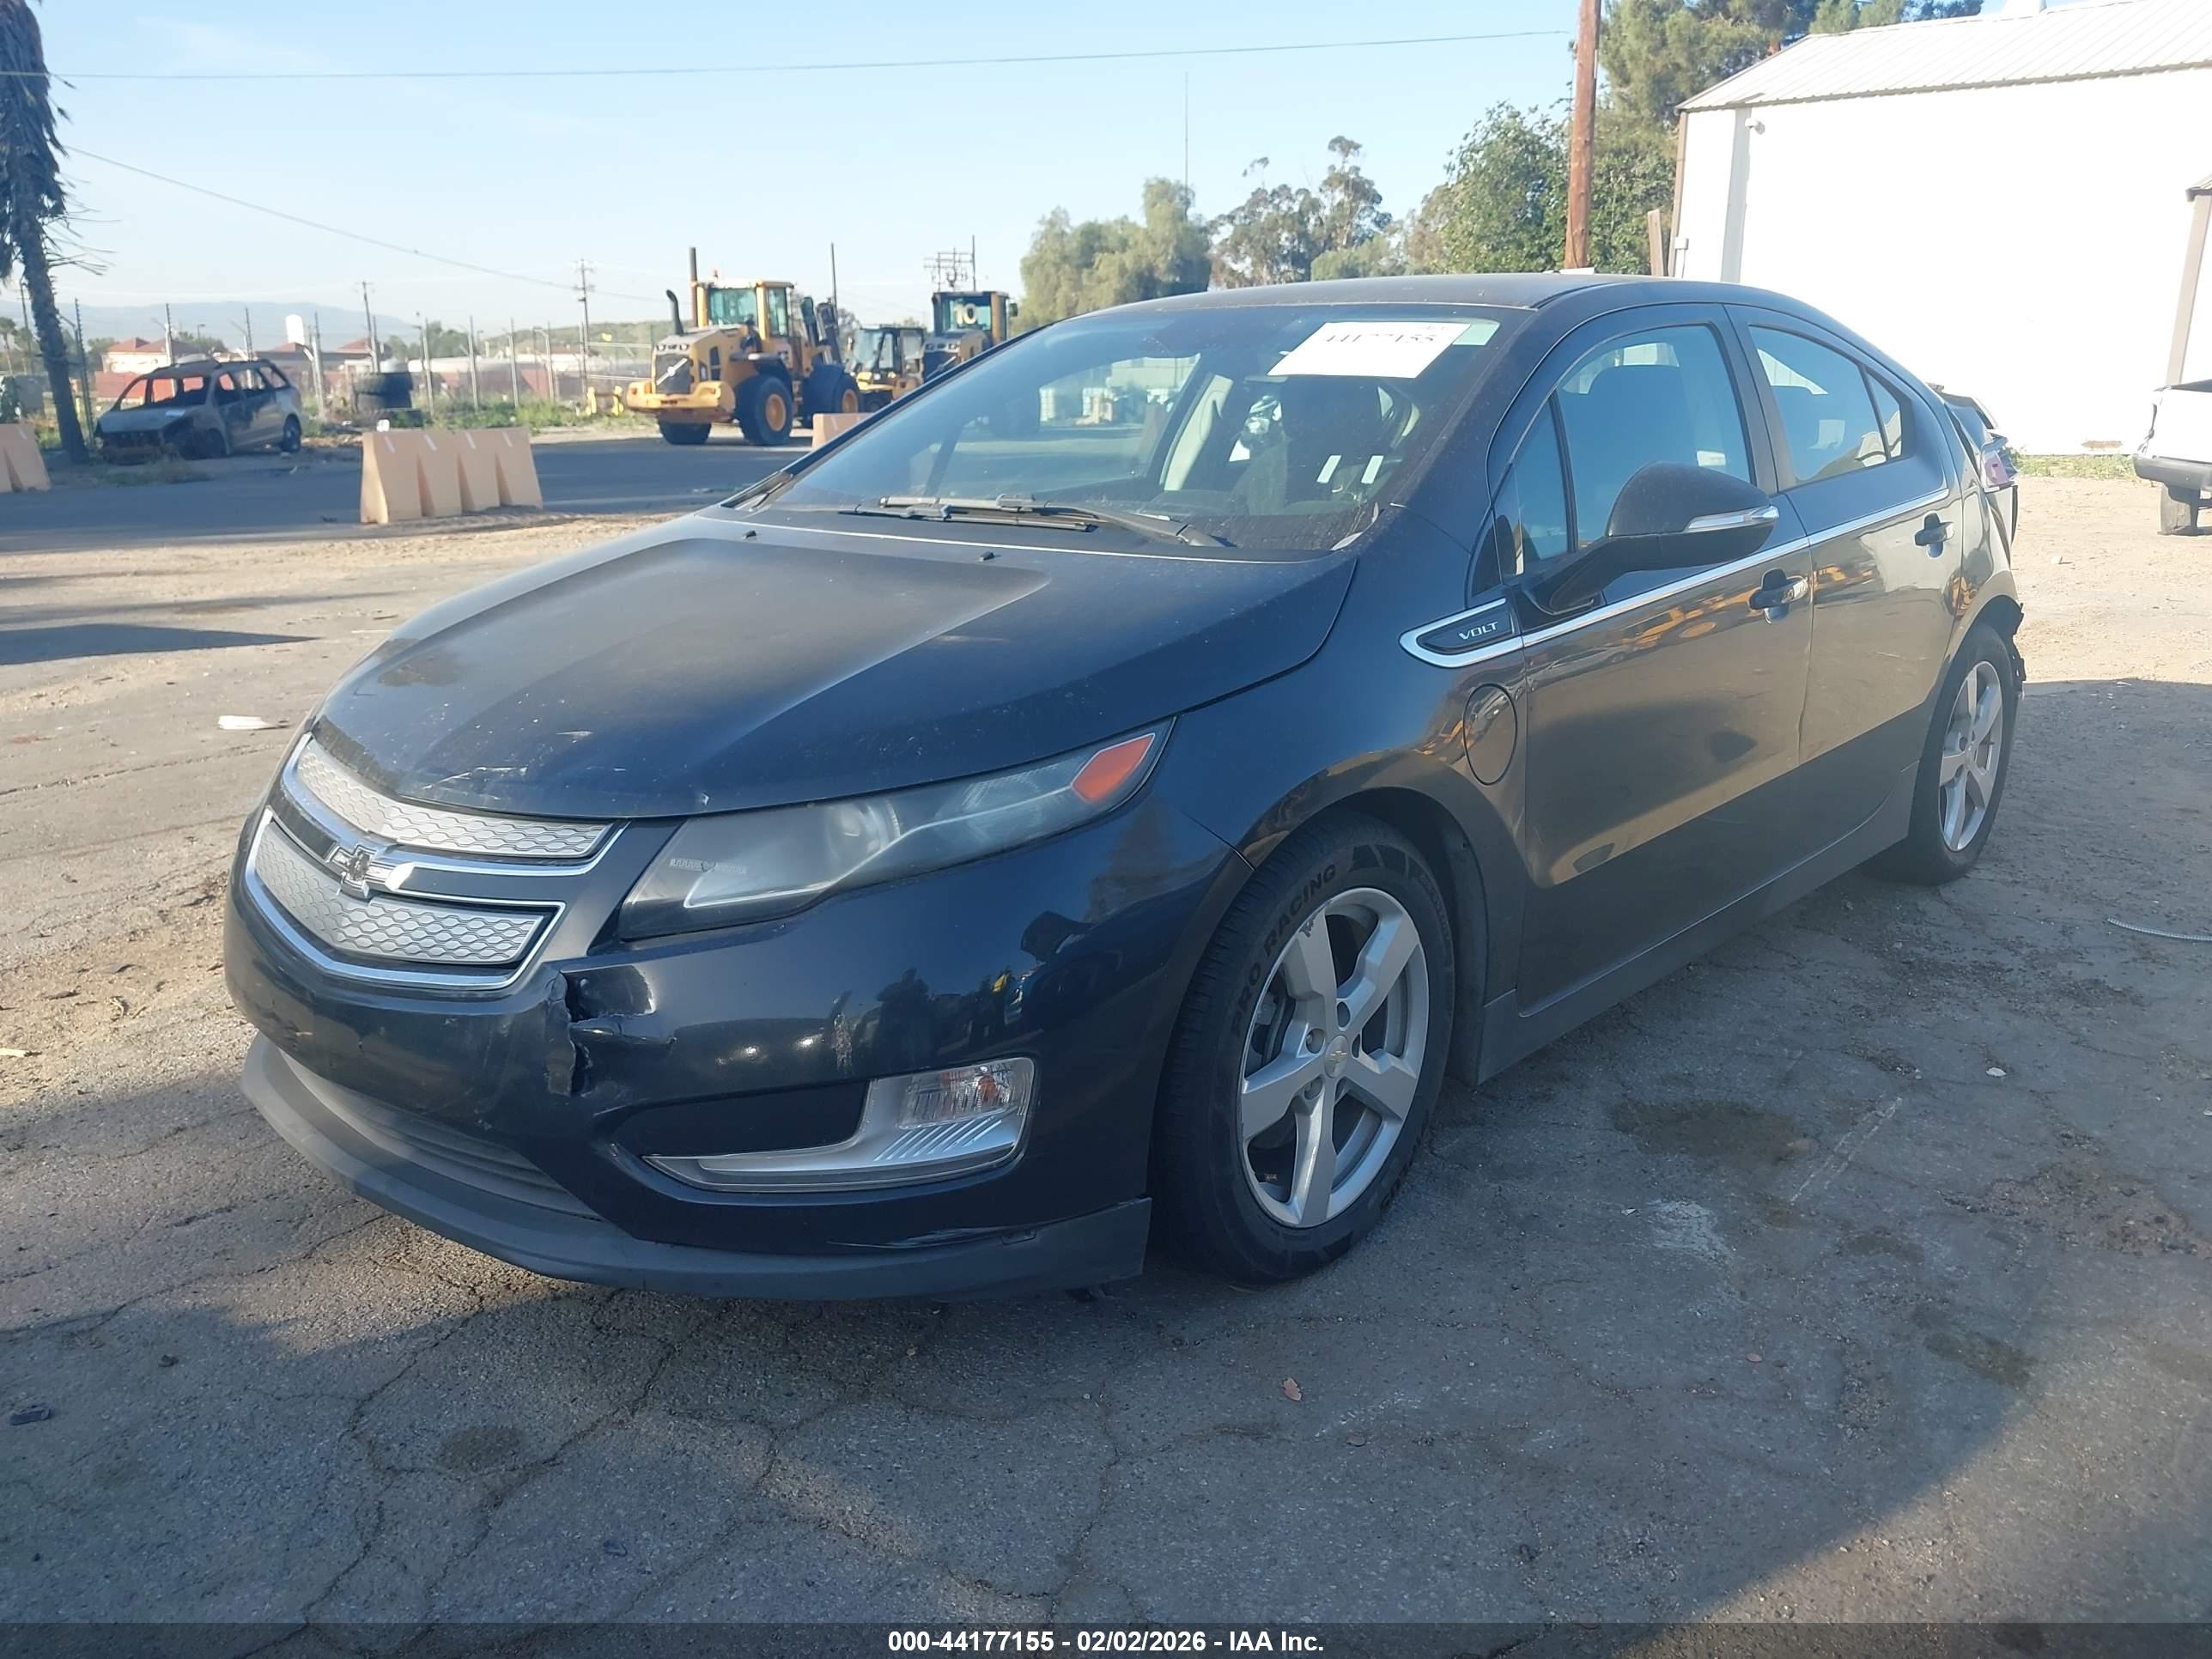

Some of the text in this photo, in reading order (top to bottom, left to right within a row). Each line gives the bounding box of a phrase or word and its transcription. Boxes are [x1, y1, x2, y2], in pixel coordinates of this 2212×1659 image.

[954, 302, 977, 326] 10
[1458, 621, 1498, 640] VOLT
[1263, 864, 1336, 957] RACING
